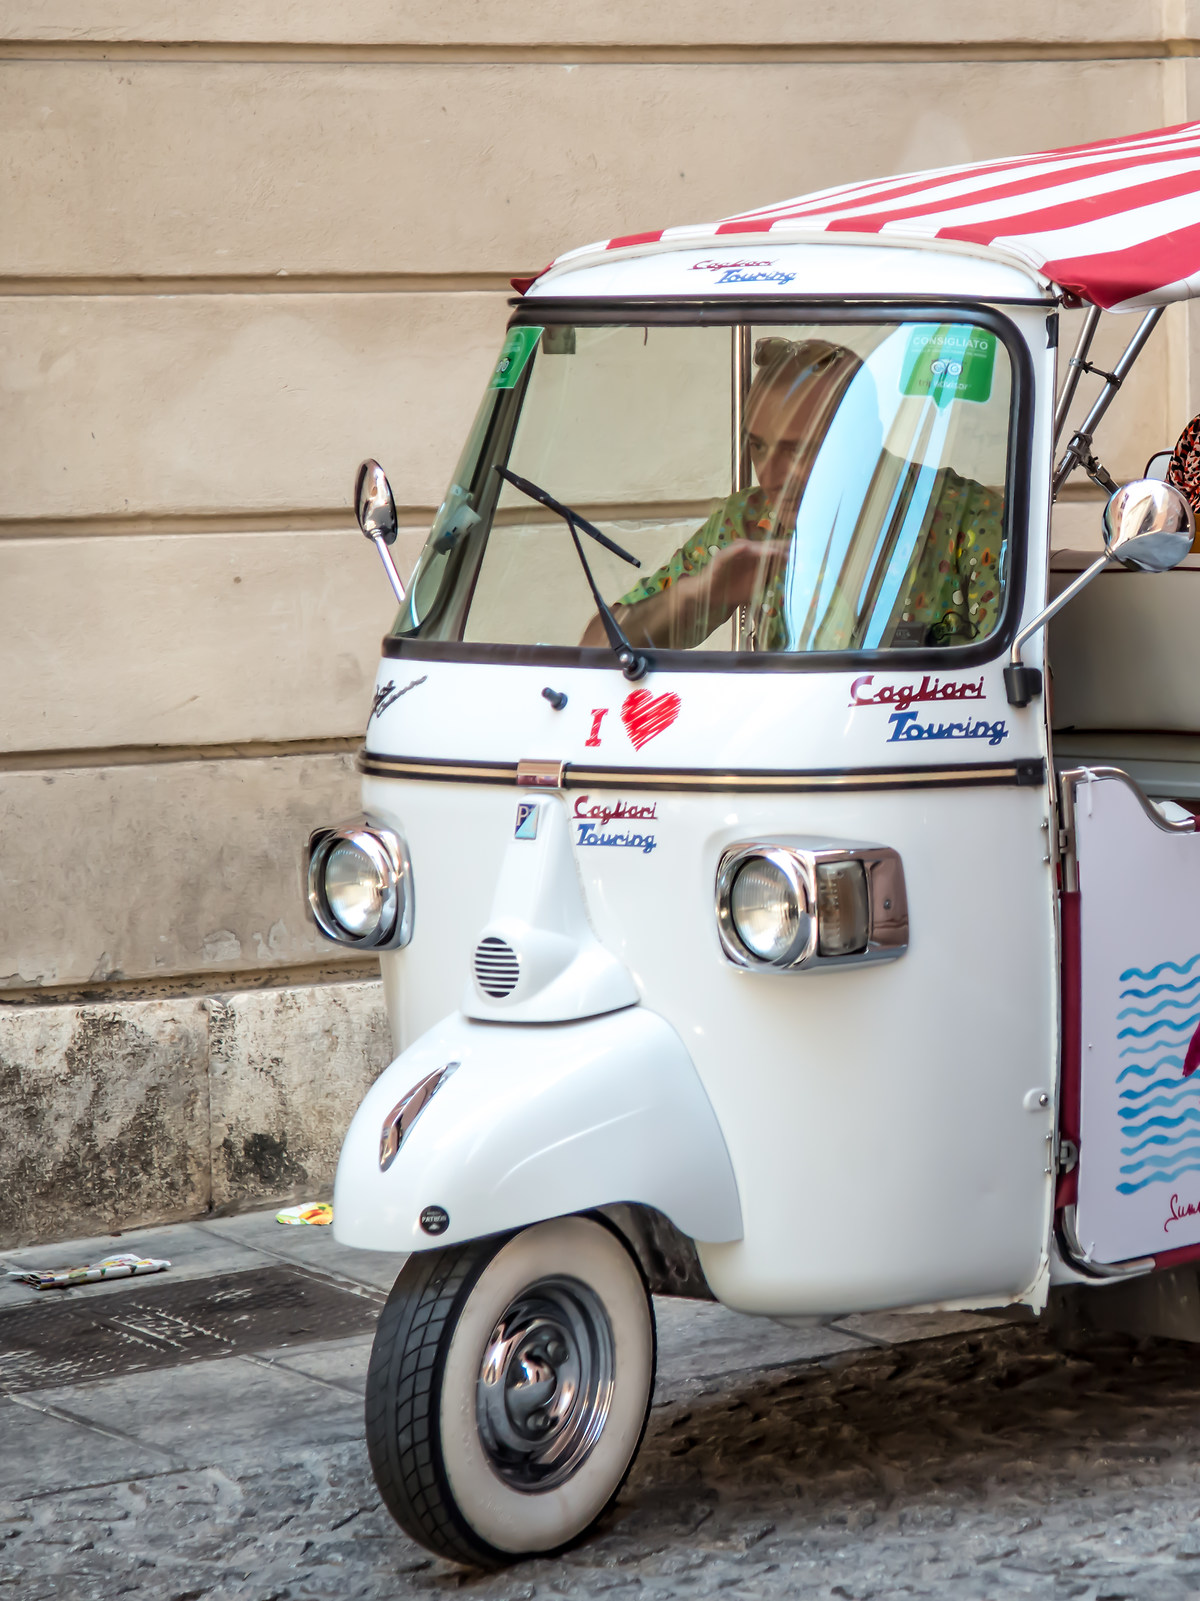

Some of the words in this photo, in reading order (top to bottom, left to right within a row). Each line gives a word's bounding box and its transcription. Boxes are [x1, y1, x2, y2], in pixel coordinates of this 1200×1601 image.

[714, 268, 797, 285] Touring
[912, 336, 989, 351] CONSIGLIATO
[848, 675, 987, 711] Cagliari
[886, 711, 1009, 746] Touring
[572, 795, 658, 825] Cagliari
[576, 823, 657, 854] Touring
